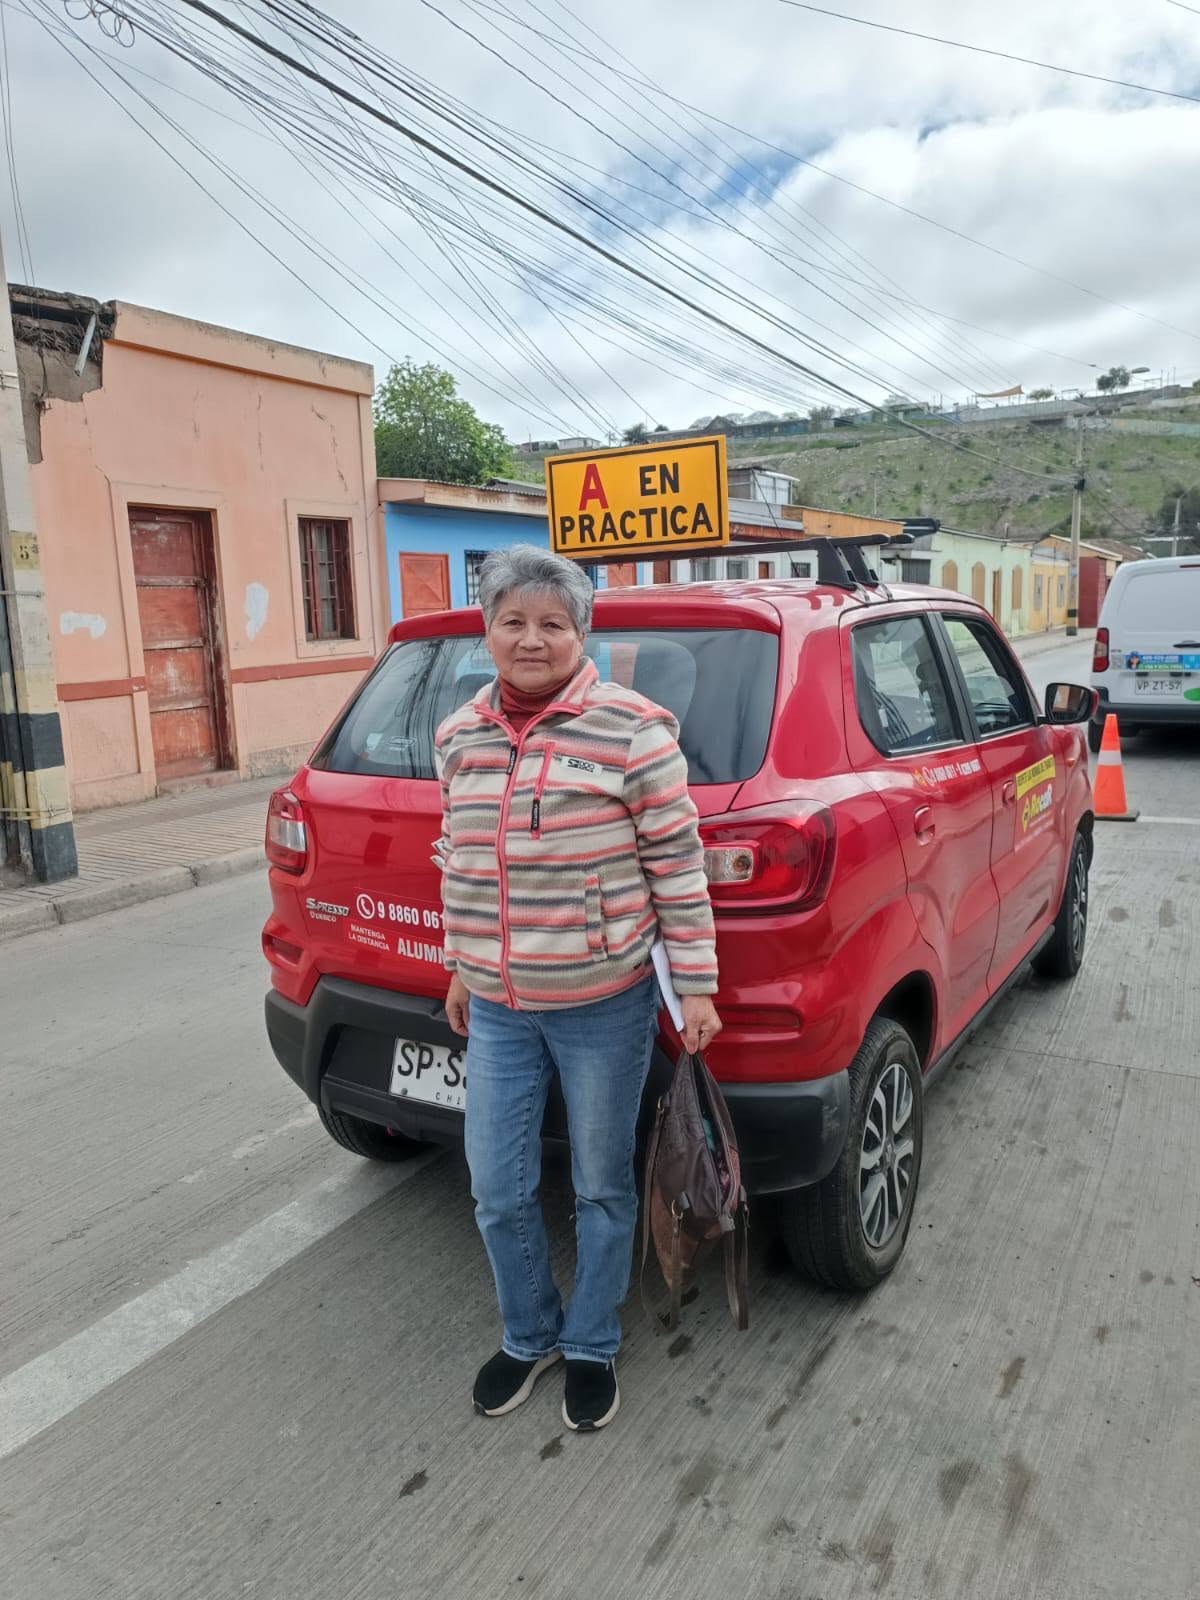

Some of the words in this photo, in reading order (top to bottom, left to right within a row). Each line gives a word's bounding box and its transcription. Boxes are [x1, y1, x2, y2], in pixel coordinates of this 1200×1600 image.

[579, 463, 609, 511] A
[639, 462, 680, 497] EN
[559, 502, 713, 545] PRACTICA
[377, 901, 385, 919] 9
[389, 903, 420, 926] 8860
[423, 910, 443, 929] 06
[348, 932, 358, 941] LA
[358, 934, 390, 951] DISTANCIA
[350, 923, 386, 940] MANTENGA
